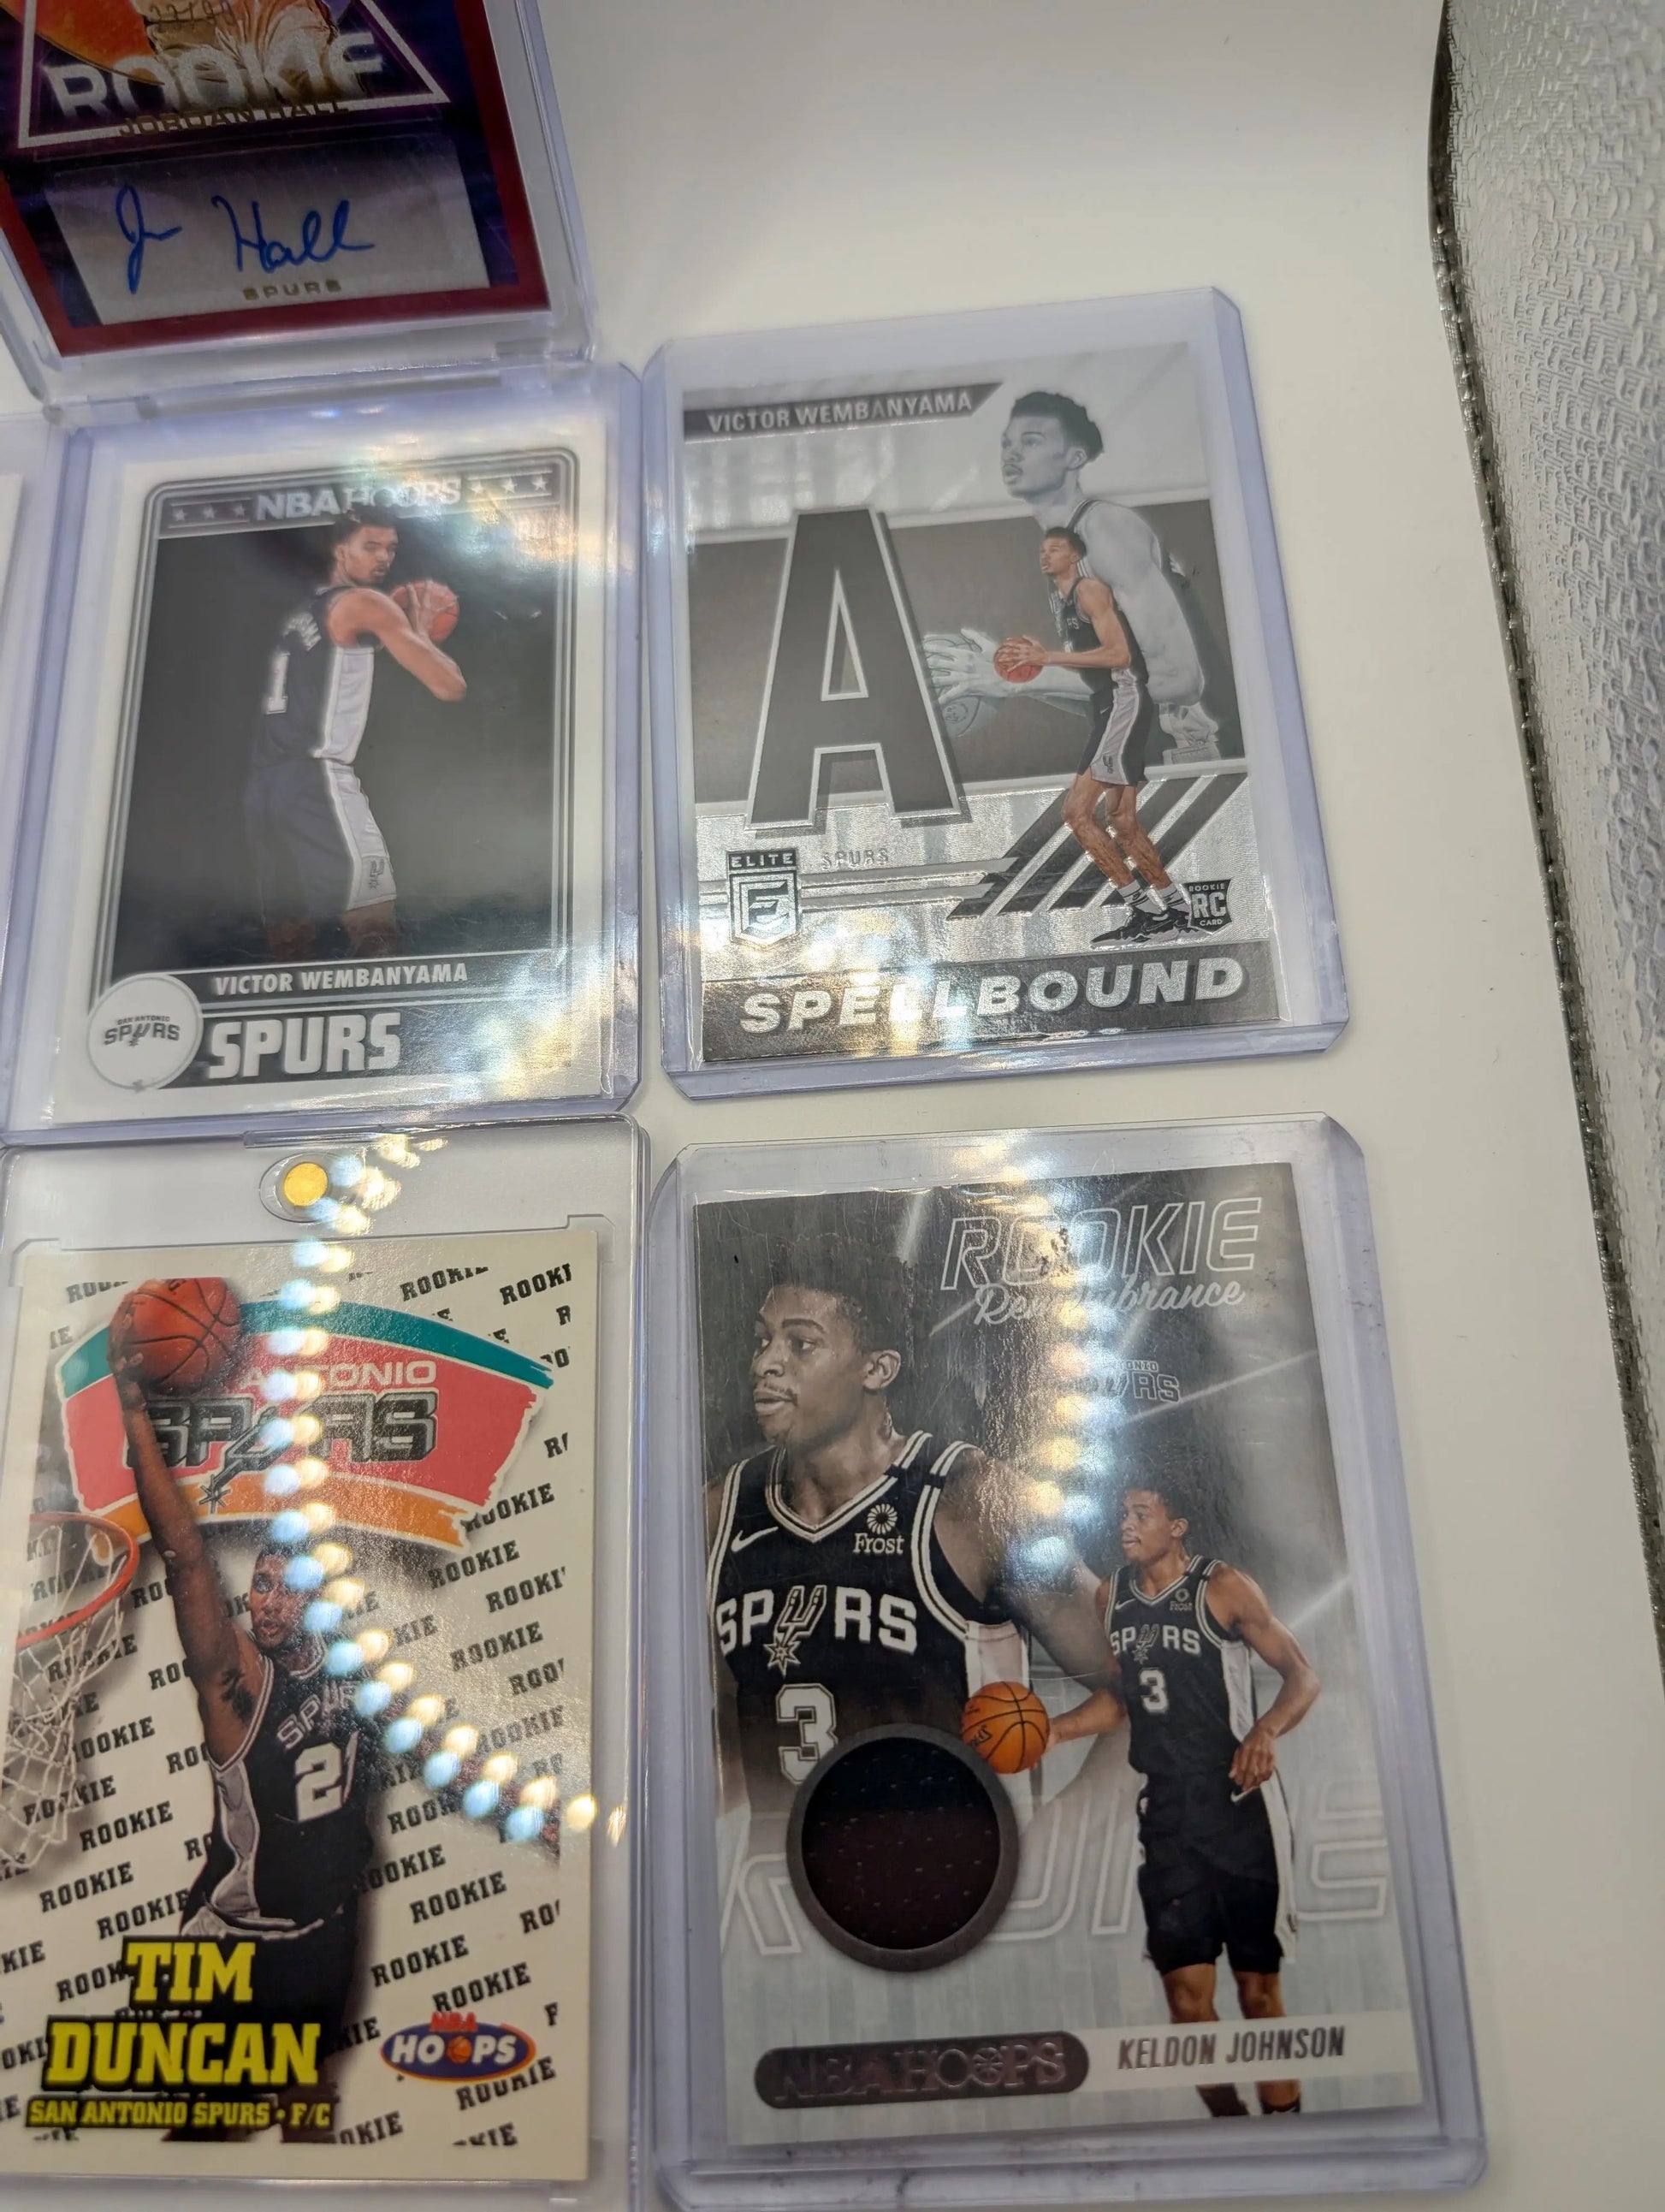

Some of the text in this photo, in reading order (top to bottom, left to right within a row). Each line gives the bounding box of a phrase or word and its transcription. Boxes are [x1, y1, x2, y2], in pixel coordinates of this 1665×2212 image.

[40, 31, 384, 119] ROOKIE
[118, 99, 350, 138] JORDAN HALL
[242, 279, 342, 300] SPURS
[708, 388, 974, 434] VICTOR WEMBANYAMA
[257, 486, 341, 521] NBA
[744, 505, 963, 833] A
[731, 852, 794, 869] ELITE
[821, 846, 890, 873] SPURS
[1188, 883, 1225, 893] ROOKIE
[1191, 892, 1227, 919] RC
[1199, 918, 1223, 927] CARD
[214, 963, 469, 996] VICTOR WEMBANYAMA
[739, 957, 1249, 1035] SPELLBOUND
[104, 1022, 181, 1047] SPURS
[208, 1012, 400, 1080] SPURS
[941, 1196, 1263, 1290] ROOKIE
[428, 1539, 521, 1590] ROOKIE
[853, 1533, 904, 1554] Frost
[485, 1565, 566, 1613] ROOKI
[716, 1585, 918, 1656] SPURS
[1110, 1623, 1202, 1663] SPURS
[450, 1621, 544, 1671] ROOKIE
[508, 1658, 565, 1695] ROO
[1139, 1667, 1168, 1713] 3
[775, 1683, 838, 1785] 3
[294, 1742, 342, 1822] 2
[79, 1800, 174, 1852] ROOKIE
[39, 1861, 134, 1913] ROOKIE
[409, 1871, 507, 1924] ROOKIE
[97, 1888, 190, 1941] ROOKIE
[125, 1941, 257, 2002] TIM
[370, 1934, 470, 1988] ROOKIE
[432, 1962, 532, 2013] ROOKIE
[430, 2011, 478, 2033] NBA
[45, 2020, 323, 2086] DUNCAN
[1118, 2025, 1345, 2070] KELDON JOHNSON
[29, 2100, 79, 2126] SAN
[80, 2101, 188, 2127] ANTONIO
[192, 2101, 271, 2127] SPURS
[291, 2102, 332, 2128] F/C
